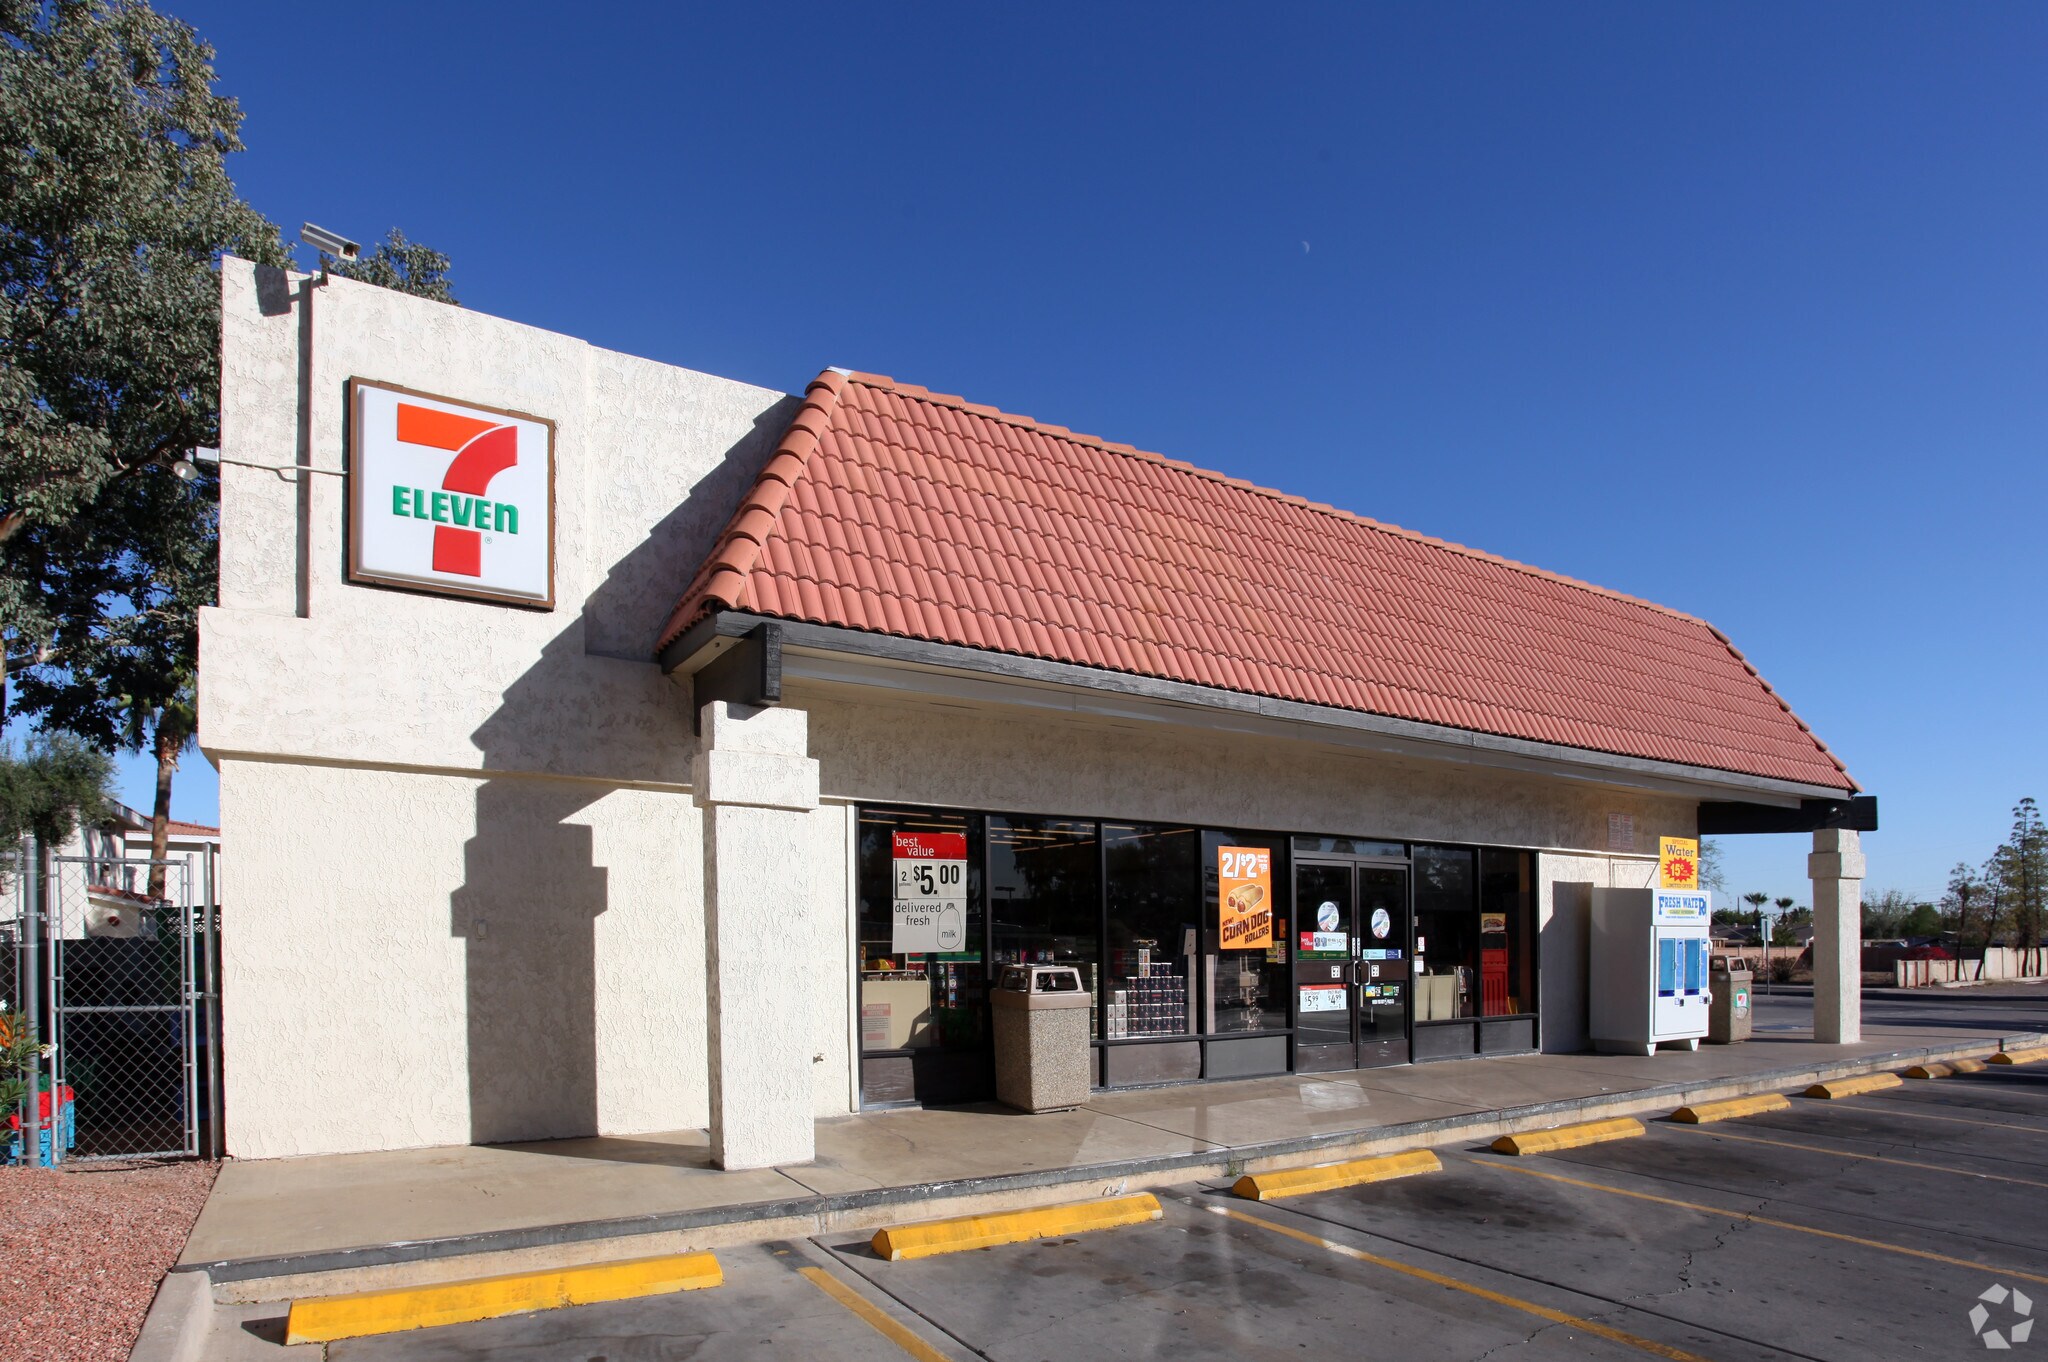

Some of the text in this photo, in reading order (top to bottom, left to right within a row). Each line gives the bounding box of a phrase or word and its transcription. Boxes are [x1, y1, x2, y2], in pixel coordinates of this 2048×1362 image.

[397, 402, 518, 578] 7
[895, 835, 919, 848] best
[906, 845, 935, 857] value
[1665, 844, 1695, 857] Water
[901, 870, 907, 882] 2
[894, 902, 941, 913] delivered
[1658, 896, 1682, 915] FRESH
[906, 915, 930, 926] fresh
[1222, 910, 1269, 943] CORN DOG
[941, 929, 957, 939] milk
[1244, 925, 1269, 944] ROLLERS
